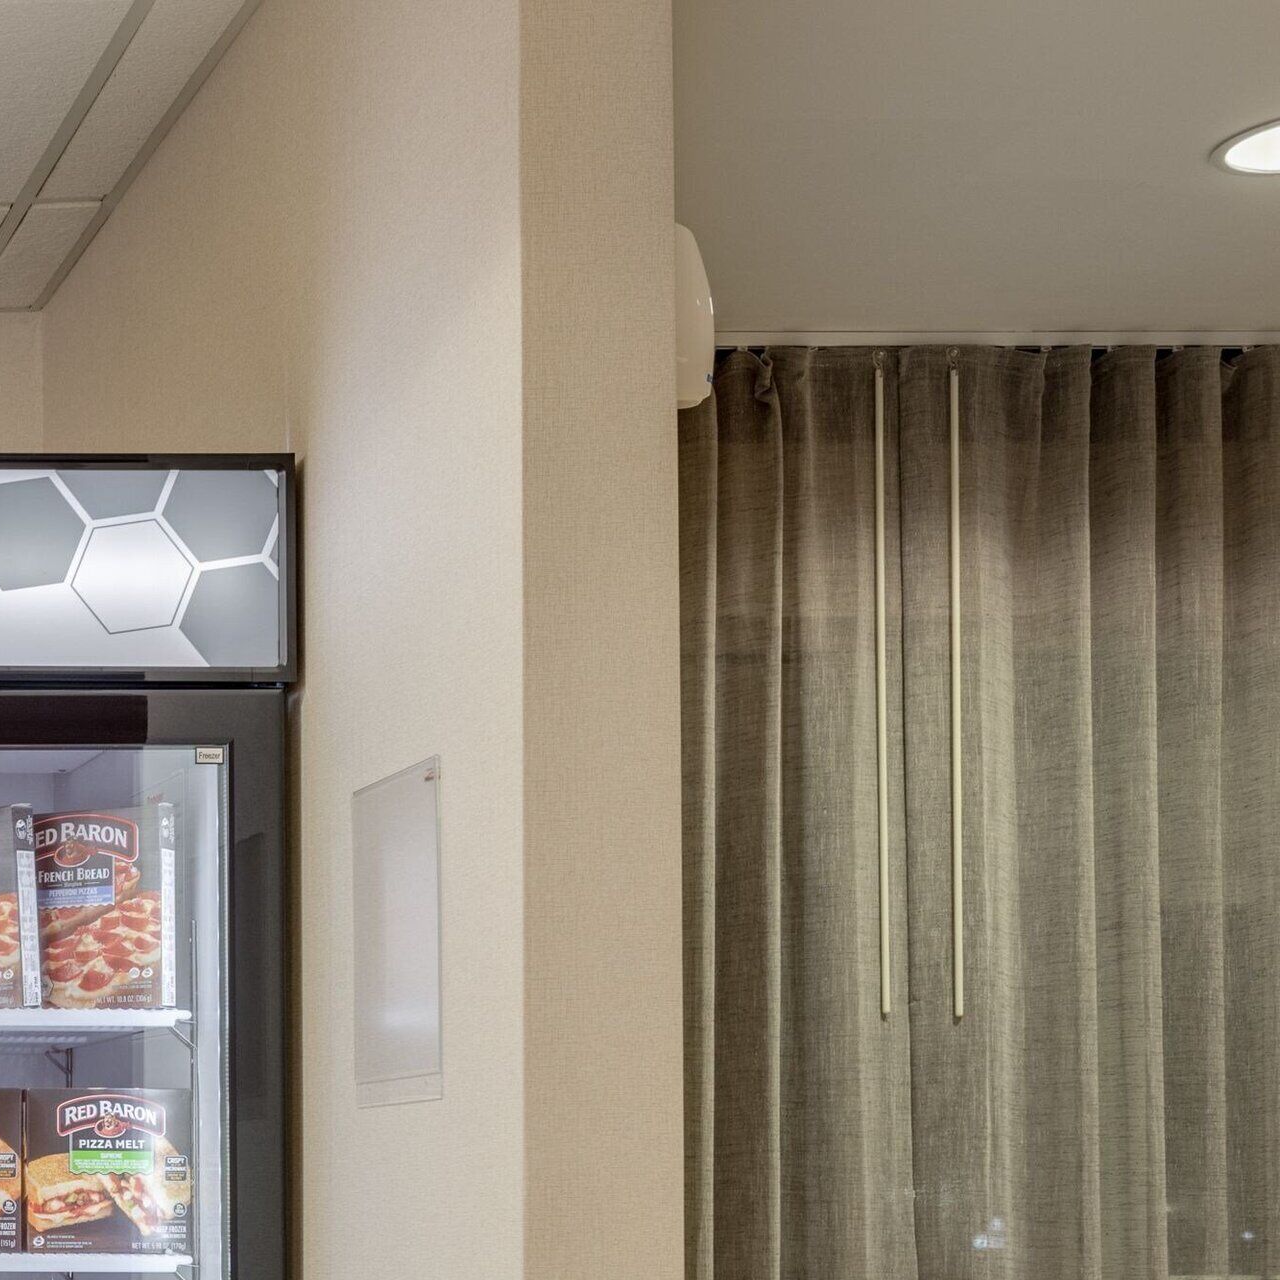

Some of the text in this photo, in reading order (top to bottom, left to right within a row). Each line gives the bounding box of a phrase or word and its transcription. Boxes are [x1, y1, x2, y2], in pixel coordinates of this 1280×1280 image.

[198, 751, 220, 760] Freezer
[60, 822, 128, 848] BARON
[38, 868, 110, 883] FRENCH BREAD
[65, 1101, 157, 1126] RED BARON
[79, 1139, 146, 1149] PIZZA MELT
